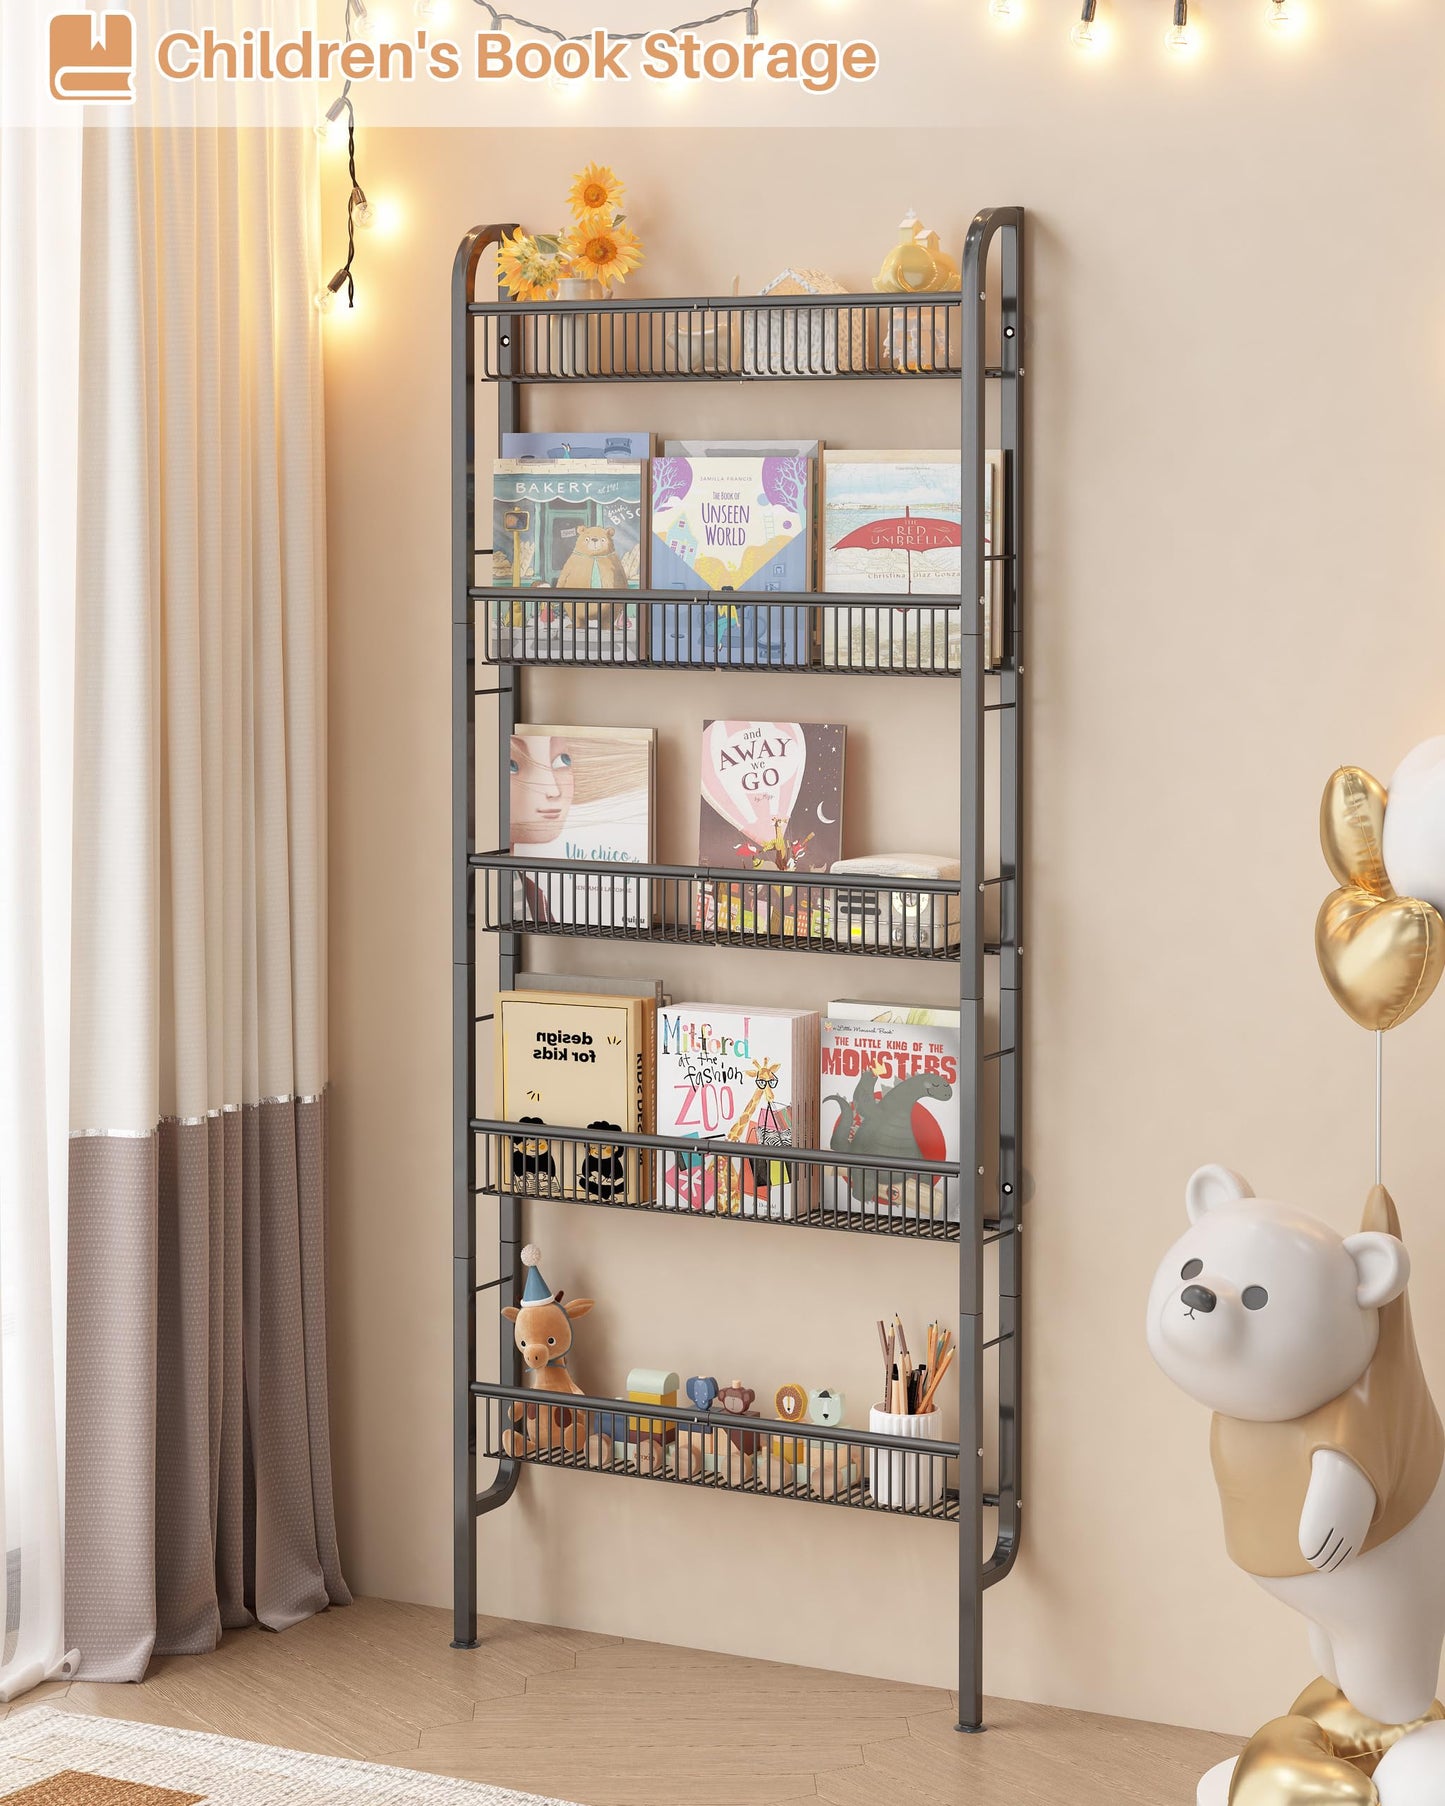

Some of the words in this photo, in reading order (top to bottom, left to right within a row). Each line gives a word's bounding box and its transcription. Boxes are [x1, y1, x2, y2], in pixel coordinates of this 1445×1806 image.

[515, 482, 592, 494] BAKERY
[701, 502, 750, 524] UNSEEN
[705, 524, 746, 546] WORLD
[897, 525, 926, 535] RED
[871, 535, 954, 546] UMBRELLA
[868, 571, 905, 579] Christina
[743, 728, 762, 740] and
[720, 738, 792, 771] AWAY
[751, 761, 765, 770] we
[741, 768, 779, 791] GO
[591, 845, 631, 861] chico
[662, 1013, 751, 1059] Mitford
[834, 1036, 849, 1047] THE
[854, 1038, 881, 1049] LITTLE
[886, 1040, 908, 1051] KING
[912, 1042, 923, 1052] OF
[929, 1043, 944, 1054] THE
[678, 1053, 691, 1067] at
[697, 1052, 717, 1066] the
[822, 1047, 957, 1084] MONSTERS
[684, 1062, 743, 1093] fashion
[674, 1084, 734, 1131] ZOO
